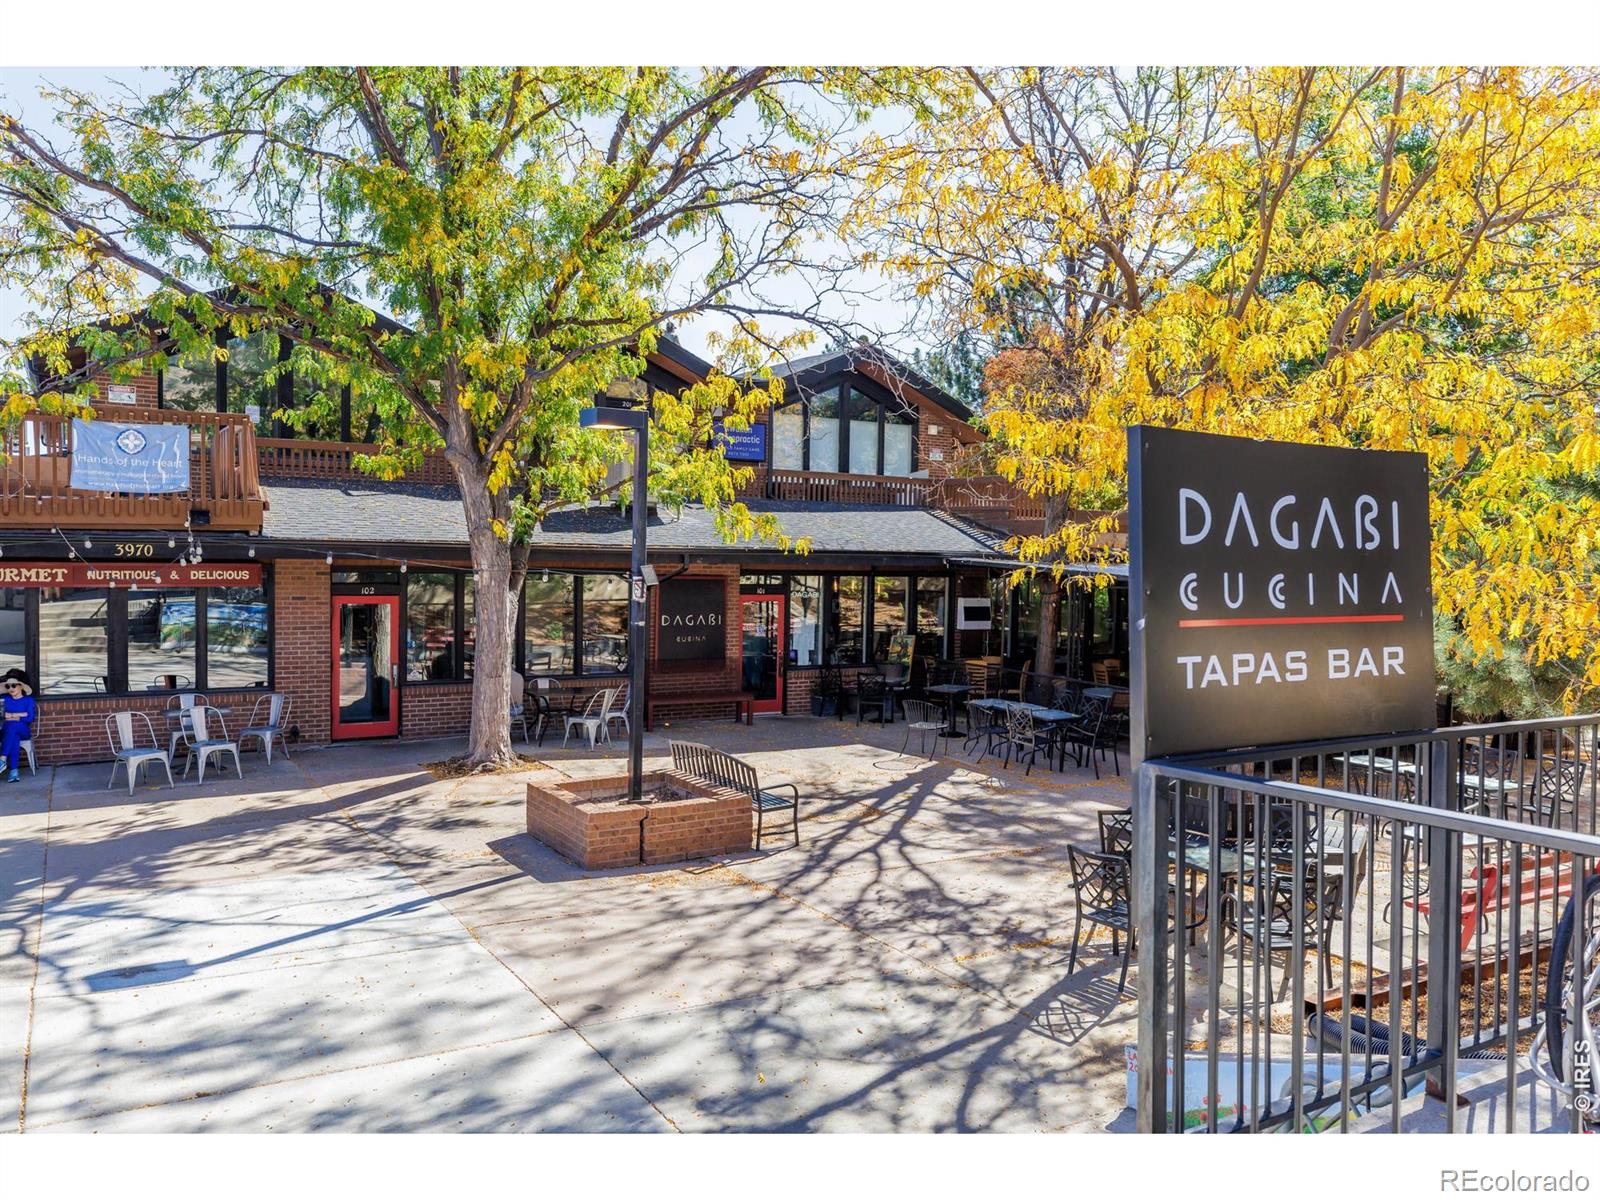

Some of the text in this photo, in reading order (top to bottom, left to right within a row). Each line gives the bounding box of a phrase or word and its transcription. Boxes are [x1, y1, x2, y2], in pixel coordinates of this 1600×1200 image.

[77, 454, 183, 470] Hands of the Heart
[1178, 487, 1400, 551] DAGABI
[114, 543, 154, 557] 3970
[87, 570, 157, 580] NUTRITIOUS
[169, 570, 180, 580] &
[190, 570, 250, 580] DELICIOUS
[360, 587, 375, 595] 102
[1178, 571, 1402, 612] CUCINA
[661, 613, 722, 626] DAGABI
[1177, 646, 1406, 690] TAPAS BAR
